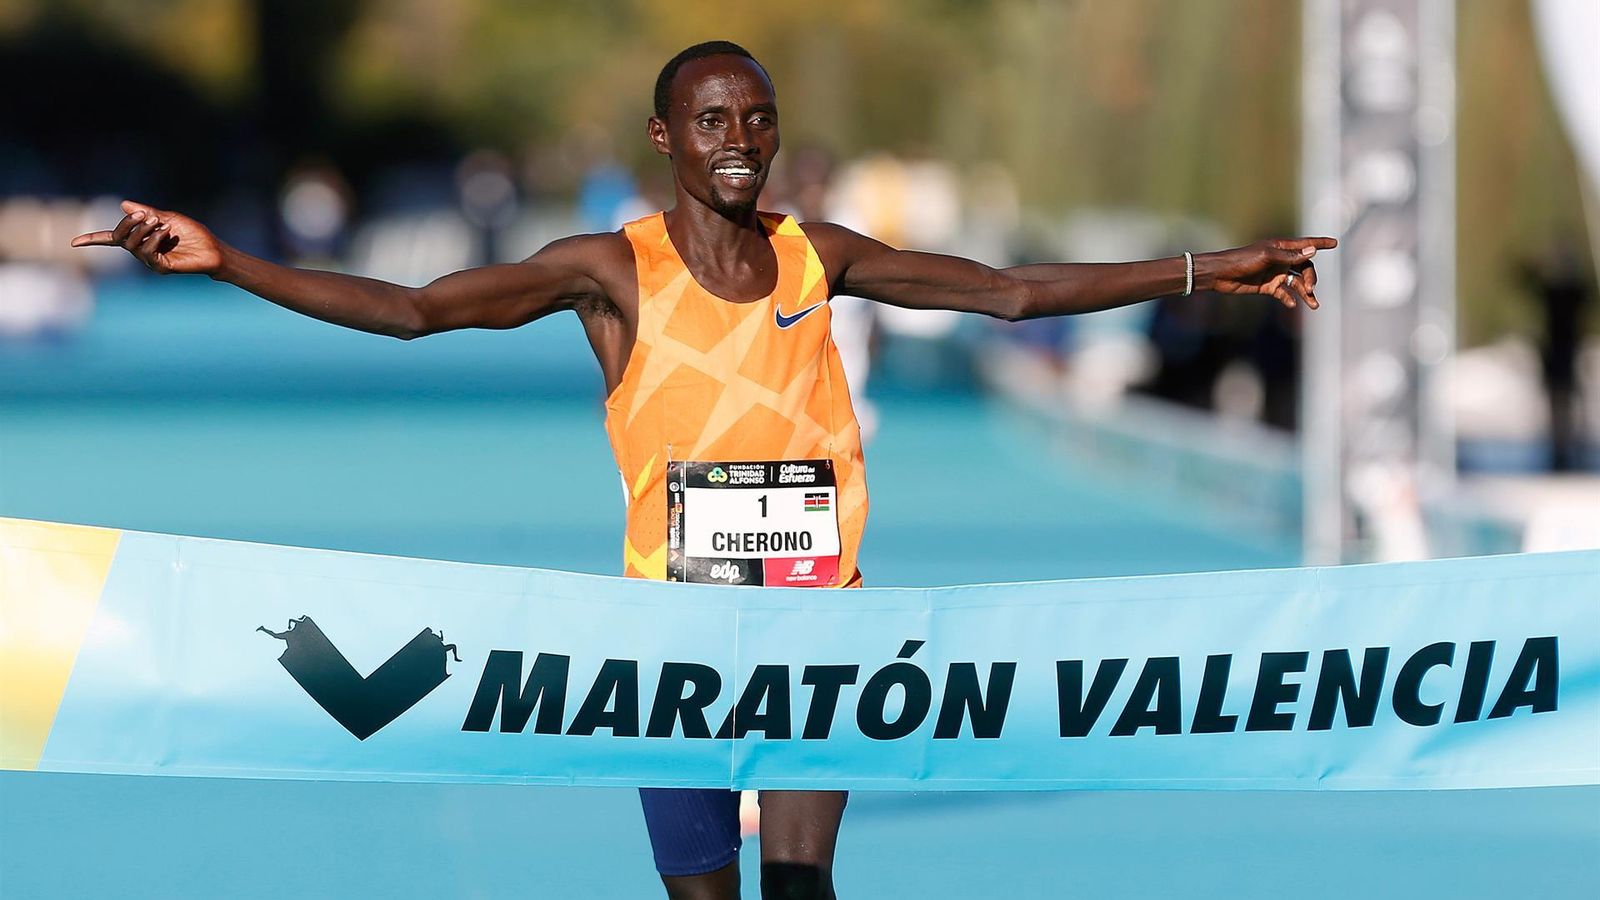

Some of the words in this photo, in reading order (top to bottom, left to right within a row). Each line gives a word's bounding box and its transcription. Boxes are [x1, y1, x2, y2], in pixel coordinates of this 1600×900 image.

[779, 474, 815, 483] Esfuerzo
[780, 464, 808, 474] Cultura
[758, 495, 767, 518] 1
[712, 531, 813, 552] CHERONO
[710, 560, 740, 583] edp
[461, 639, 1017, 741] MARATÓN
[1056, 636, 1559, 738] VALENCIA
